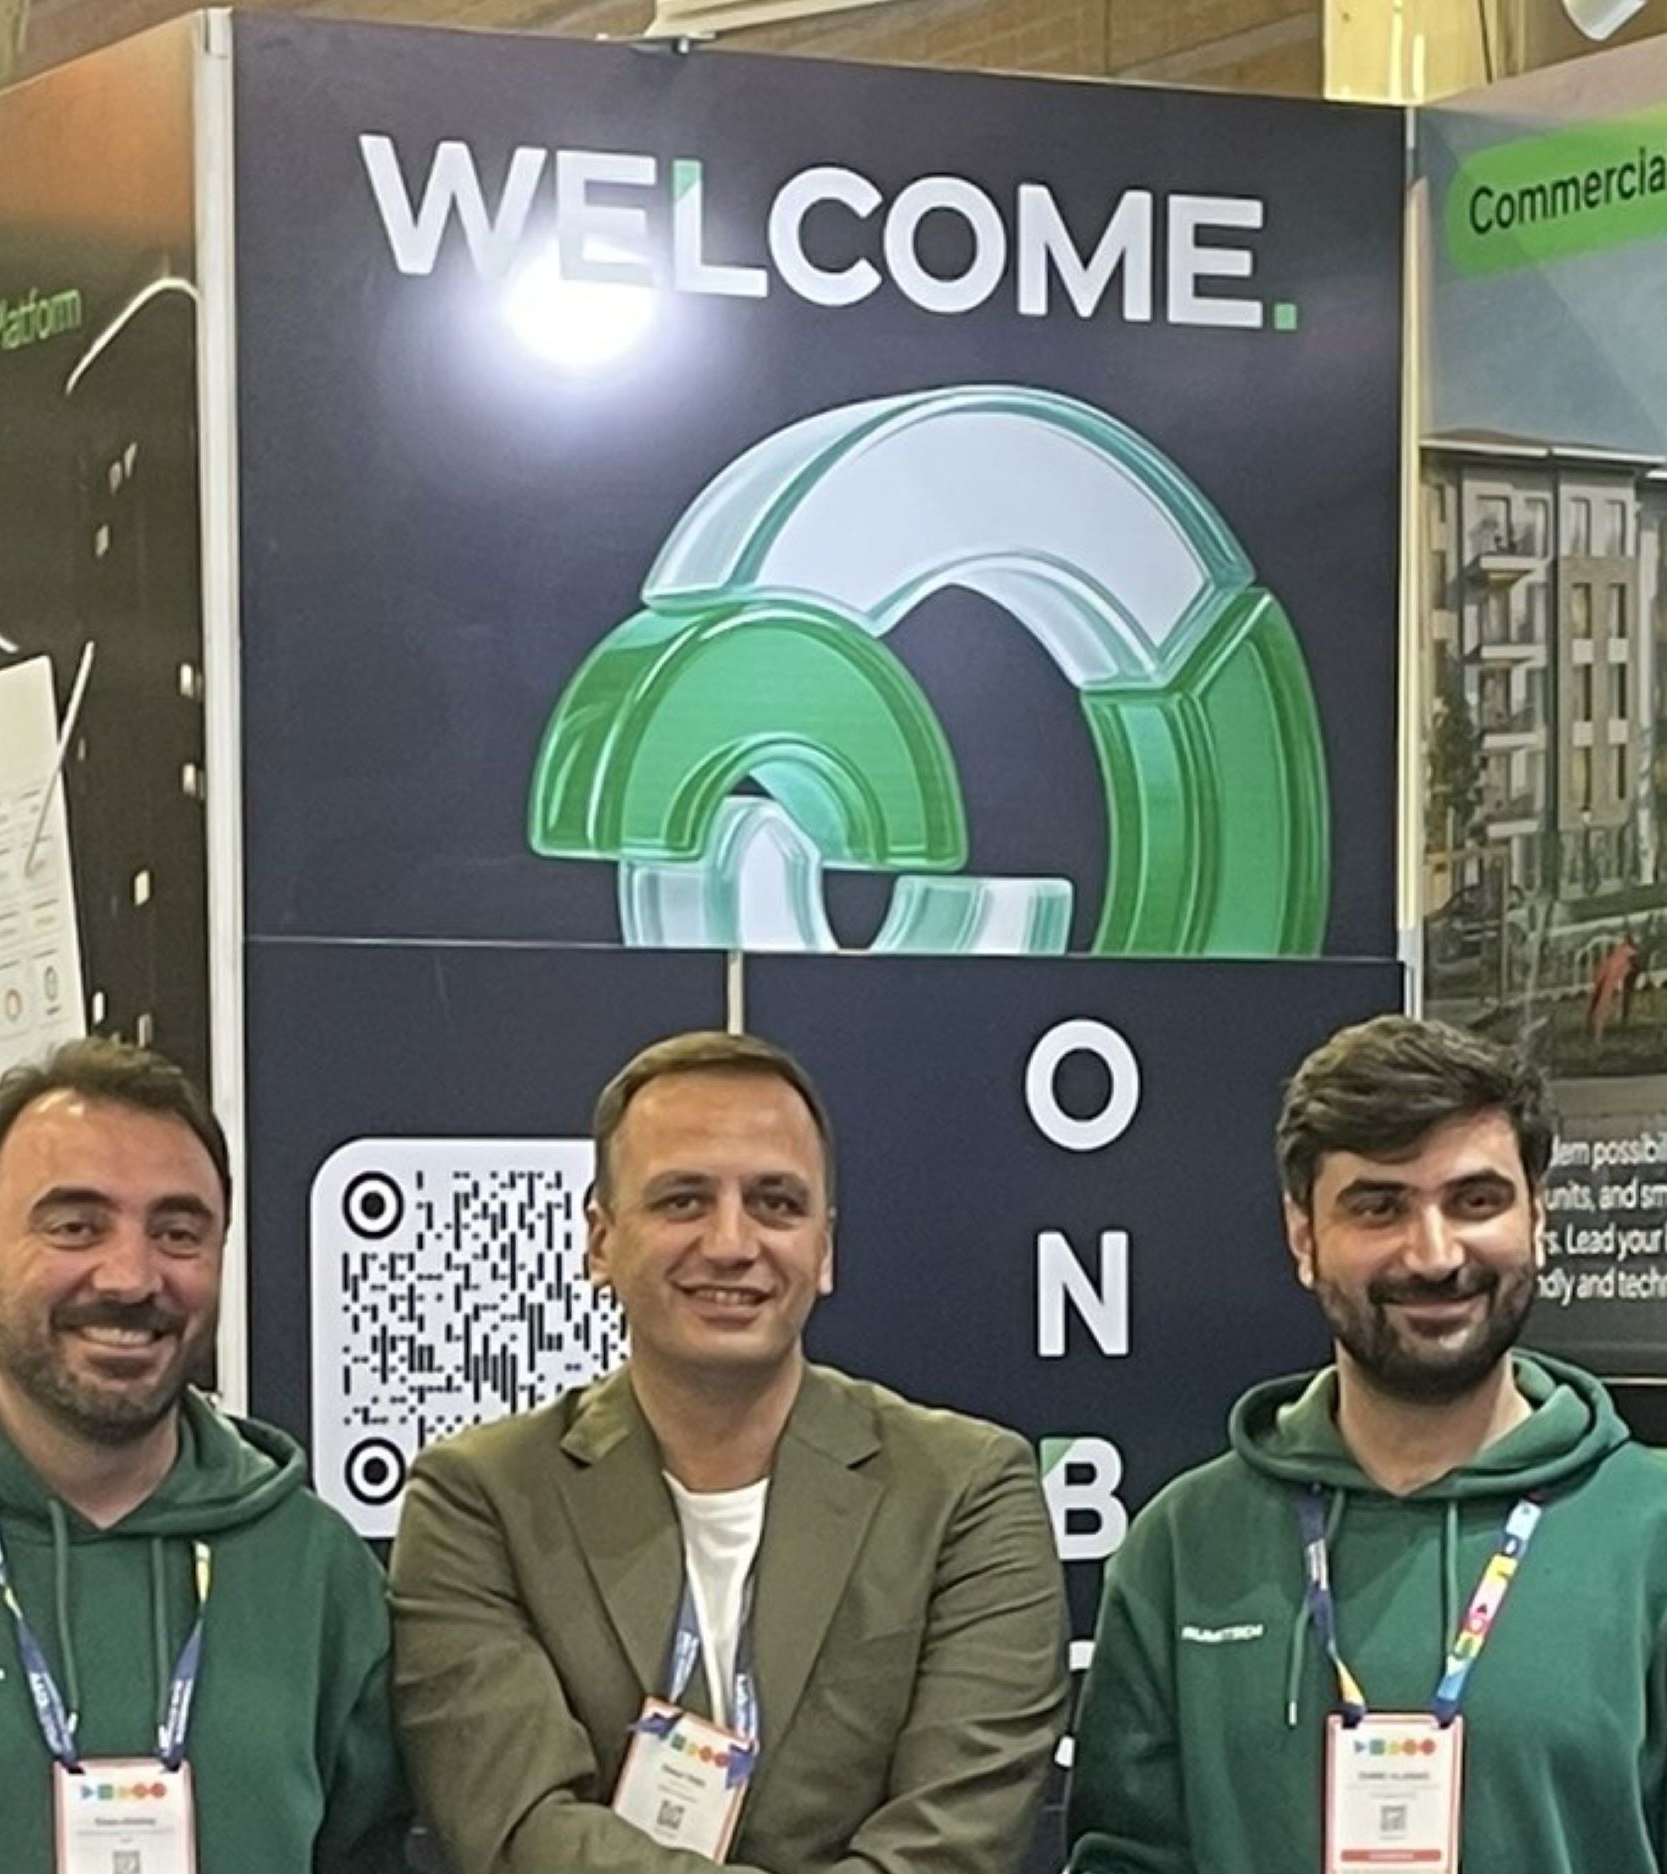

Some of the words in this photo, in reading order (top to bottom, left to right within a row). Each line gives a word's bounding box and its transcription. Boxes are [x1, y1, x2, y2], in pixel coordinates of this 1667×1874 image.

[358, 132, 1298, 330] WELCOME.
[1599, 1177, 1639, 1210] and
[1566, 1222, 1615, 1254] Lead
[1617, 1228, 1663, 1262] your
[1576, 1265, 1615, 1299] and
